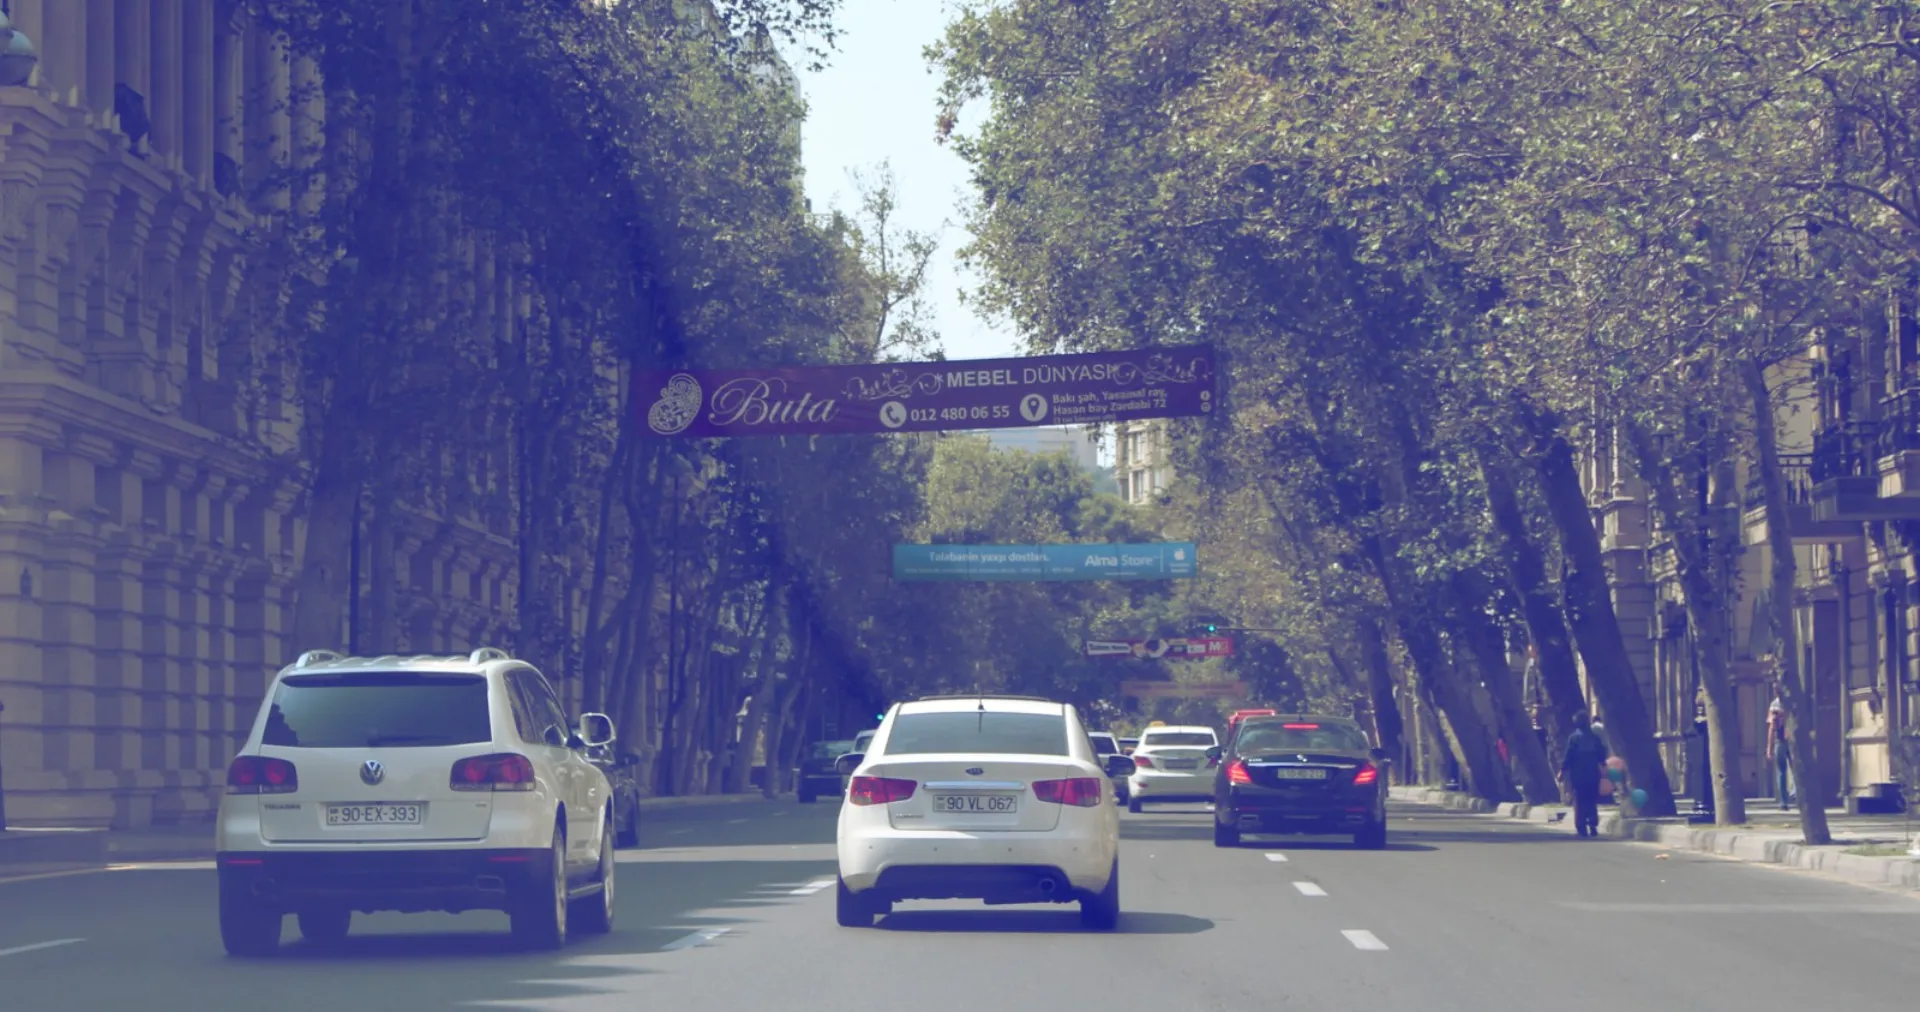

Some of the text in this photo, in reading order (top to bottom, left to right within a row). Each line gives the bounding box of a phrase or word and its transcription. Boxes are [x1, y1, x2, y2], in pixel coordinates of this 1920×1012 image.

[947, 364, 1111, 388] MEBEL DÜNYASI
[708, 376, 840, 426] Buta
[1153, 398, 1167, 409] 72
[910, 404, 1011, 422] 012 480 06 55
[1084, 554, 1153, 567] Alma Store
[946, 796, 1014, 811] 90 VL 067
[341, 806, 417, 822] 90-EX-393
